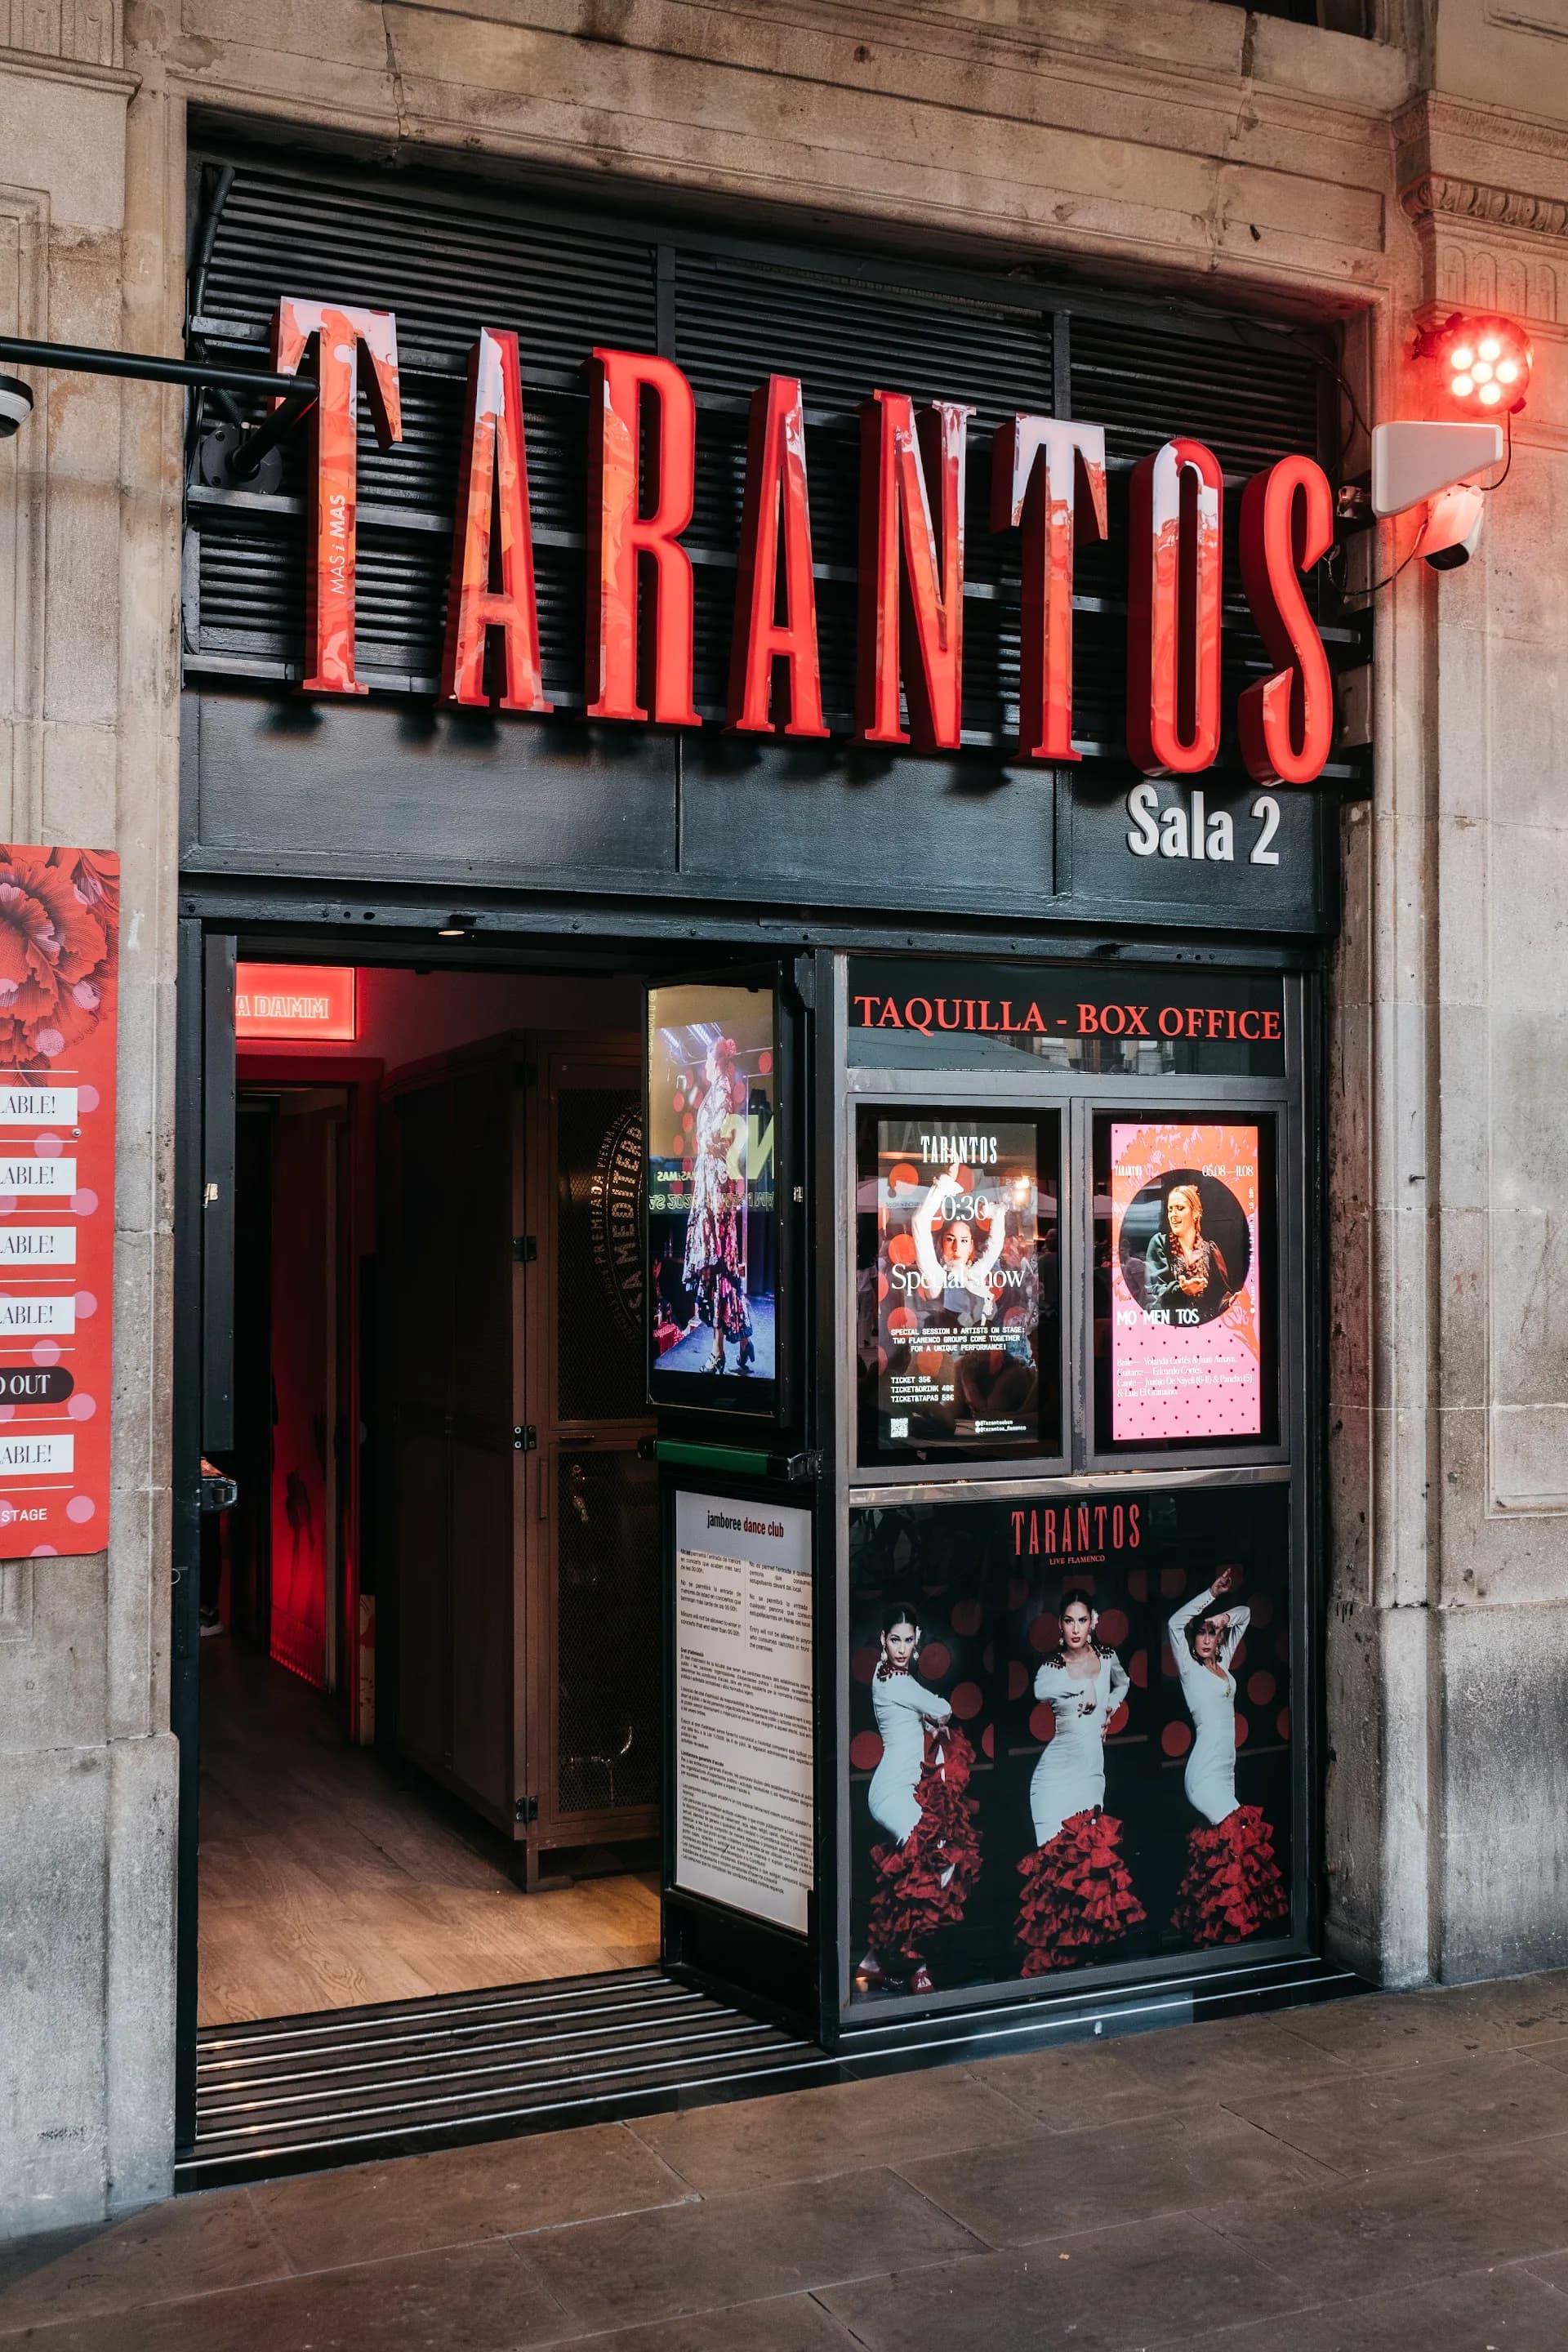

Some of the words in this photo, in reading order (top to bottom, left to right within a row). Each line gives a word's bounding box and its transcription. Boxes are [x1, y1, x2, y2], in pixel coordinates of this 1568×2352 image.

[329, 494, 345, 539] MAS
[272, 296, 1334, 786] TARANTOS
[331, 543, 345, 552] i
[329, 555, 345, 595] MAS
[1127, 784, 1234, 862] Sala
[1250, 796, 1281, 865] 2
[254, 996, 329, 1019] DAMM
[853, 996, 1048, 1037] TAQUILLA
[1076, 1004, 1151, 1036] BOX
[1158, 1007, 1281, 1040] OFFICE
[0, 1095, 56, 1114] ABLE!
[920, 1136, 998, 1164] TARANTOS
[0, 1166, 54, 1184] ABLE!
[1115, 1165, 1143, 1176] TARANTOS
[0, 1236, 54, 1254] ABLE!
[0, 1306, 53, 1324] ABLE!
[1116, 1310, 1138, 1326] MO
[1143, 1309, 1170, 1325] MEN
[1175, 1308, 1200, 1325] TOS
[890, 1328, 920, 1336] SPECIAL
[922, 1327, 951, 1335] SESSION
[908, 1336, 941, 1344] FLAMENCO
[943, 1335, 968, 1343] GROUPS
[934, 1344, 958, 1352] UNIQUE
[960, 1343, 1007, 1352] PERFORMANCE!
[10, 1374, 51, 1395] OUT
[890, 1376, 915, 1384] TICKET
[0, 1444, 51, 1464] ABLE!
[1, 1508, 47, 1522] STAGE
[706, 1510, 742, 1531] jamboree
[743, 1517, 766, 1535] dance
[768, 1521, 784, 1538] club
[1011, 1503, 1140, 1555] TARANTOS
[1049, 1557, 1066, 1566] LIVE
[1067, 1554, 1106, 1565] FLAMENCO
